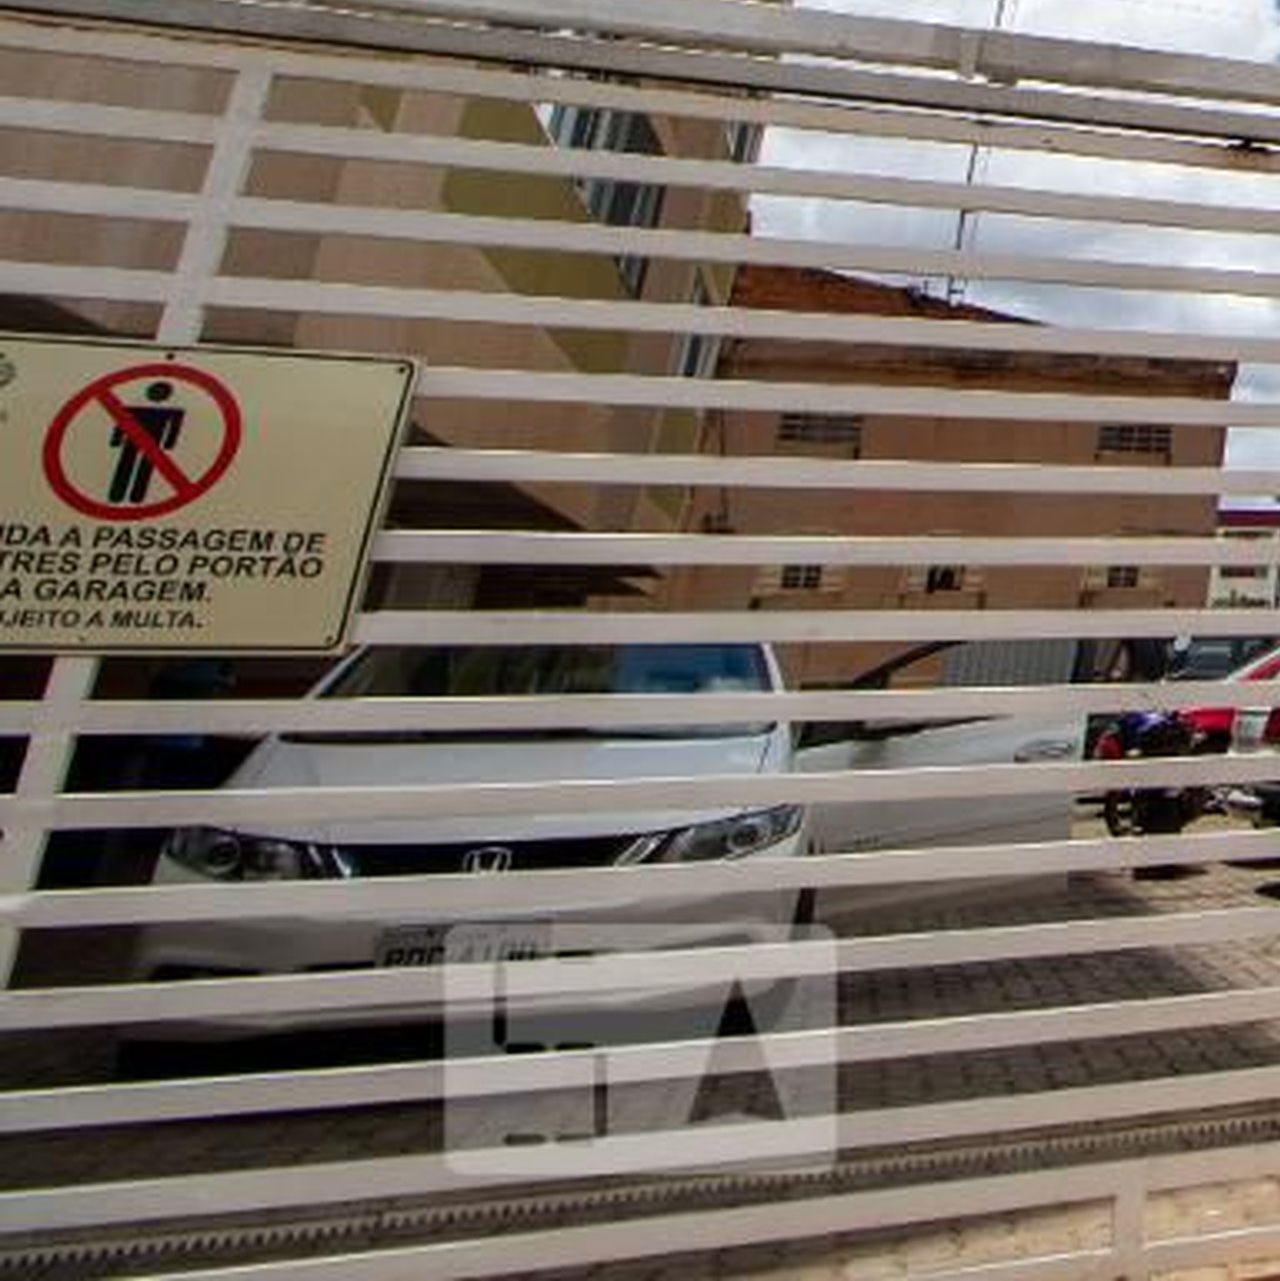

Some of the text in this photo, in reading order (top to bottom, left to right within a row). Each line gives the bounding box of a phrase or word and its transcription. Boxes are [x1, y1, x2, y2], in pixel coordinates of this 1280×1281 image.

[59, 525, 82, 548] A
[92, 526, 275, 552] PASSAGEM
[283, 531, 326, 553] DE
[88, 552, 179, 575] PELO
[34, 578, 212, 602] GARAGEM.
[85, 609, 104, 628] A
[109, 609, 203, 629] MULTA.
